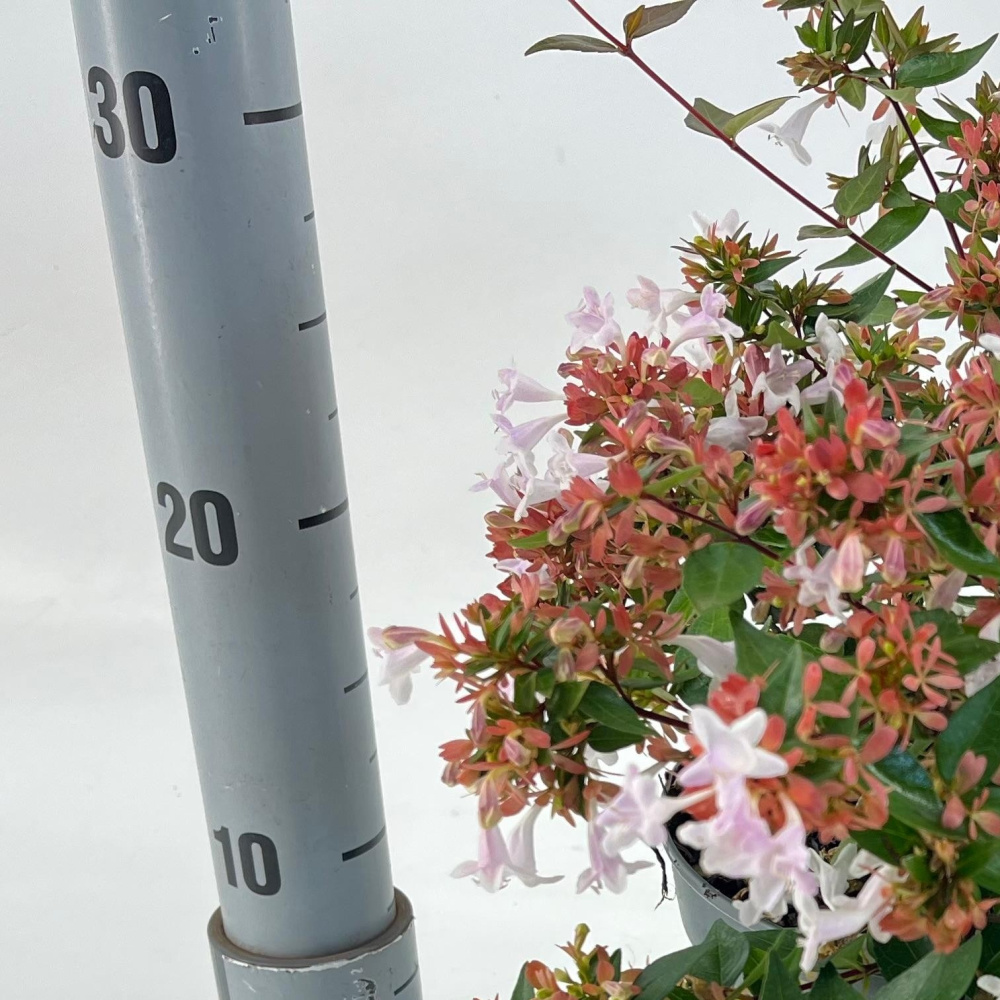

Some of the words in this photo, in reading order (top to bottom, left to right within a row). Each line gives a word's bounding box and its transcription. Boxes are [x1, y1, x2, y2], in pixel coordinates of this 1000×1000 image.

[87, 66, 178, 164] 30
[157, 482, 239, 567] 20
[213, 826, 282, 896] 10
